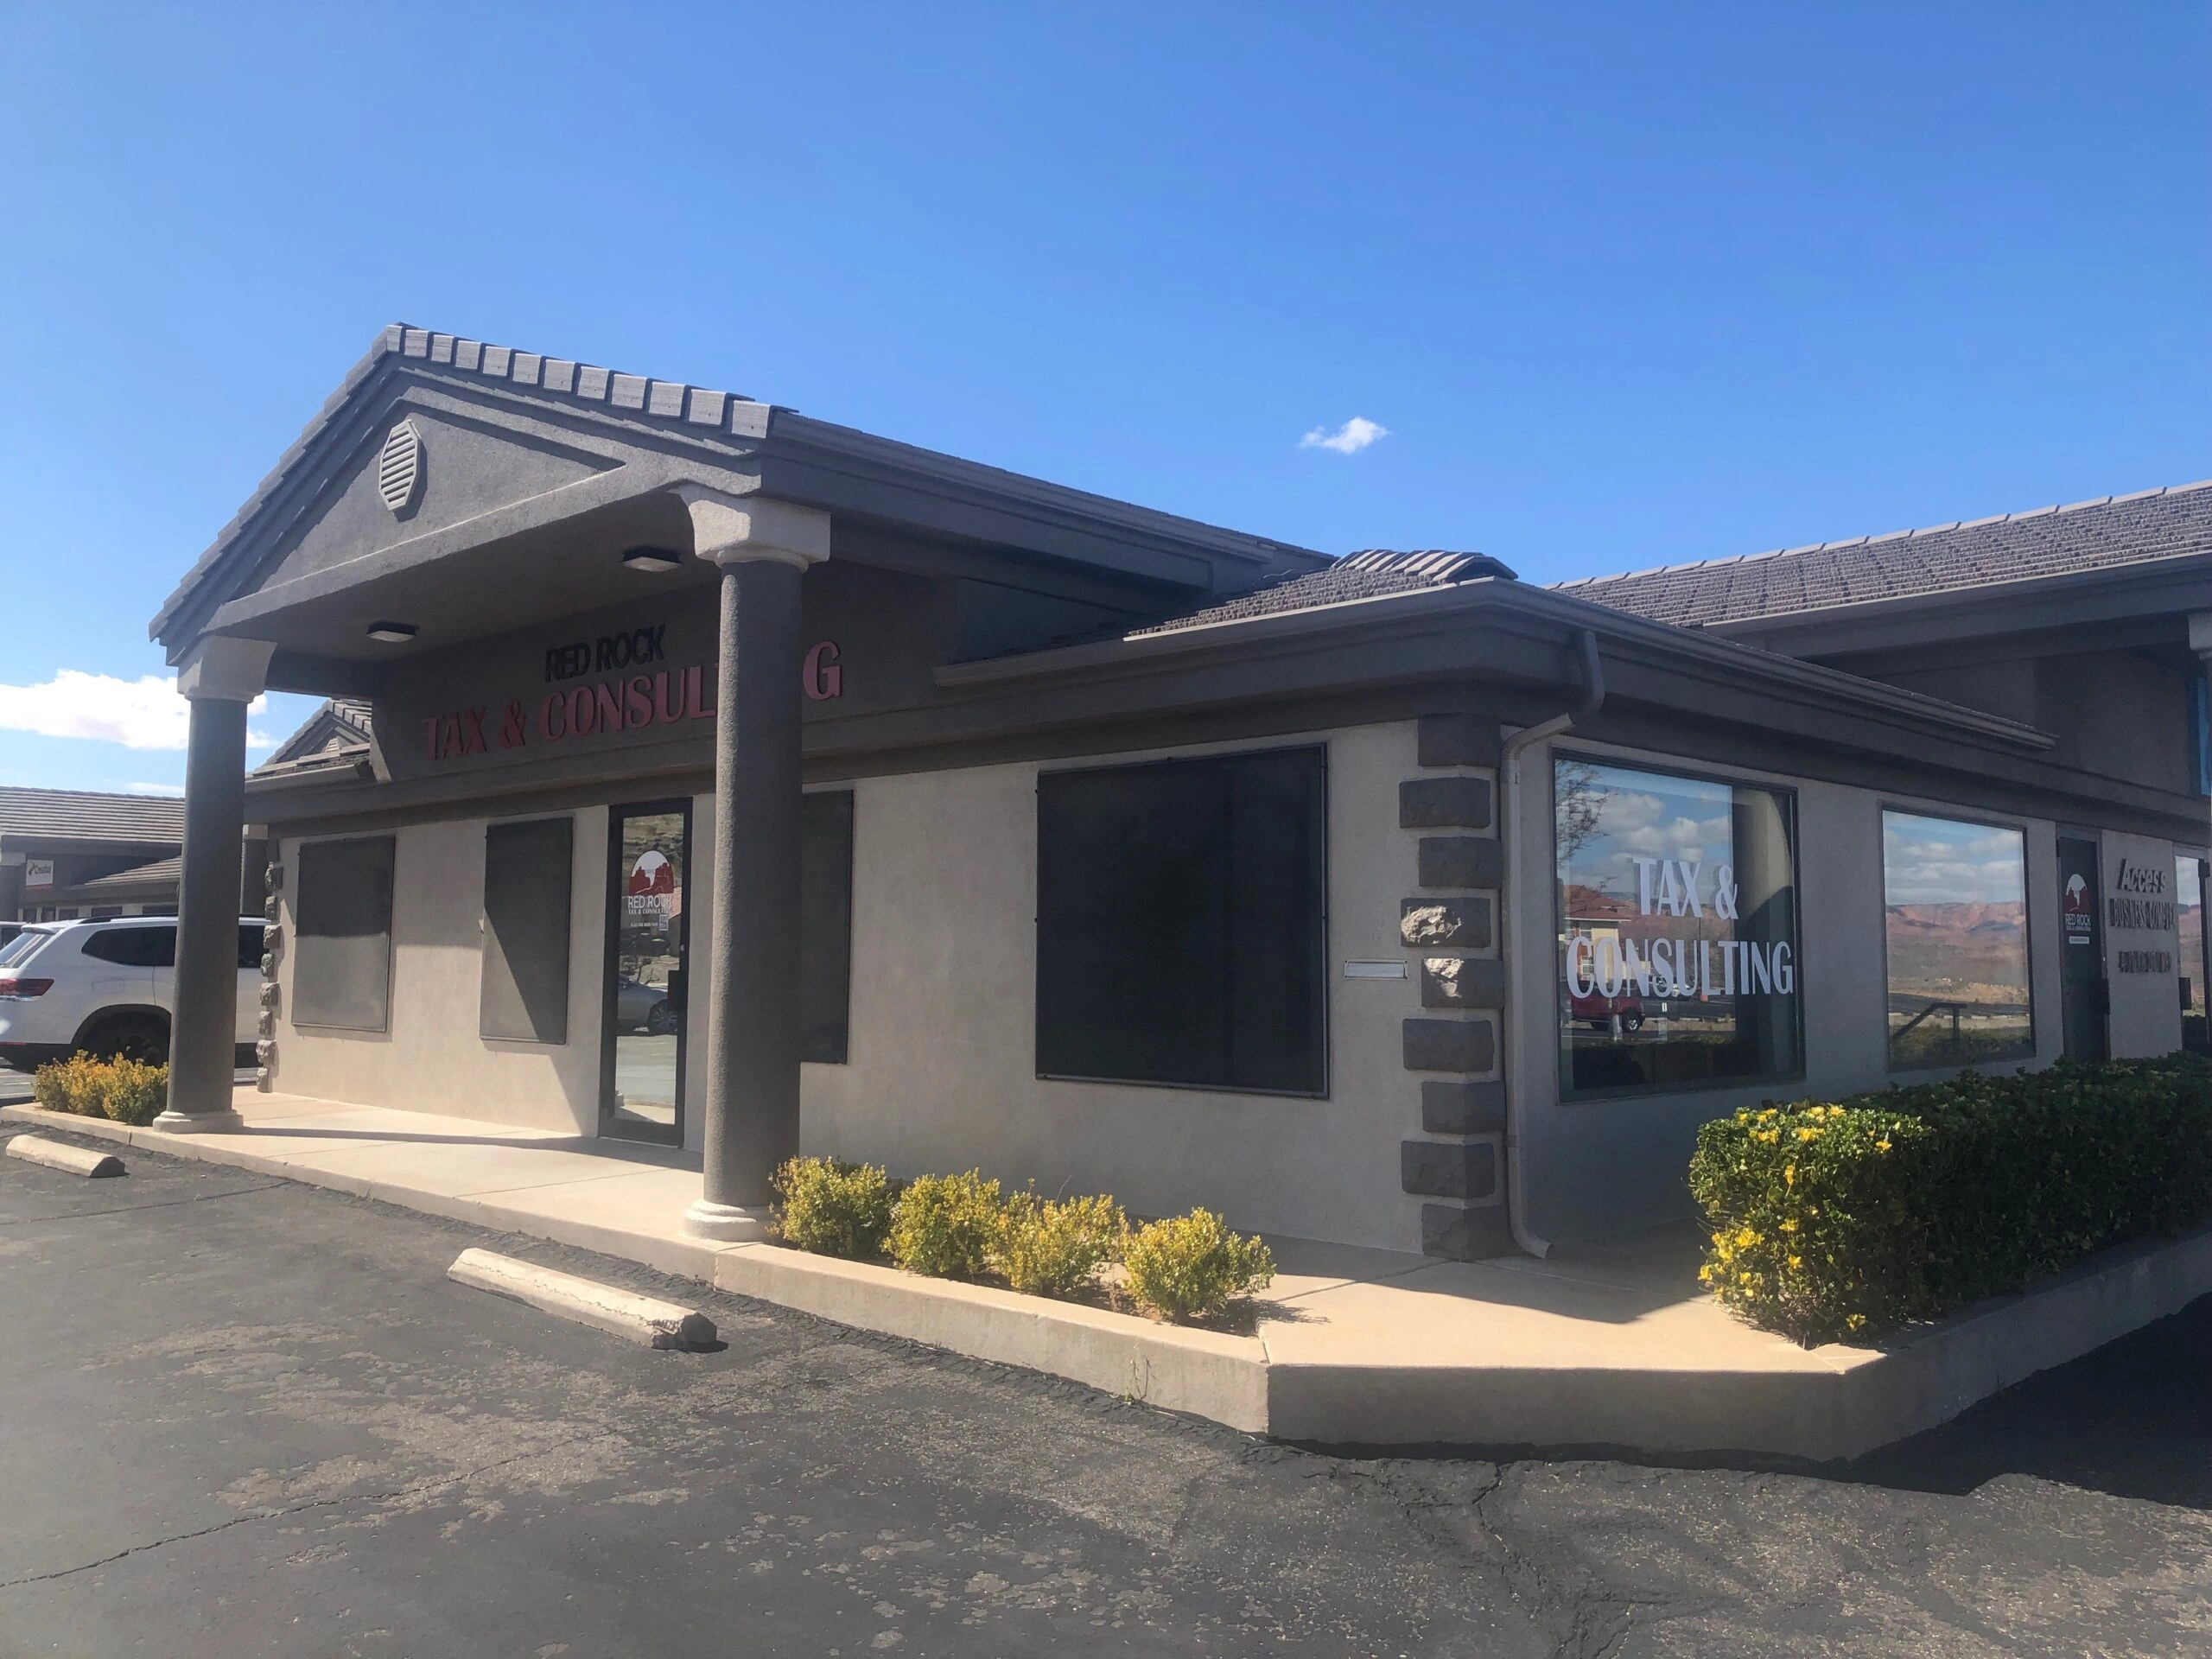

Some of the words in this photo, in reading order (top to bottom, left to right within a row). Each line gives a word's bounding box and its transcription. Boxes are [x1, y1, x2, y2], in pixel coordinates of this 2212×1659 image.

[544, 642, 591, 683] RED
[595, 625, 666, 672] ROCK
[422, 706, 488, 760] TAX
[498, 699, 526, 751] &
[539, 640, 842, 743] CONSULG
[628, 895, 645, 908] RED
[648, 894, 672, 908] ROCK
[1632, 856, 1704, 918] TAX
[1715, 864, 1739, 920] &
[1566, 936, 1795, 999] CONSULTING
